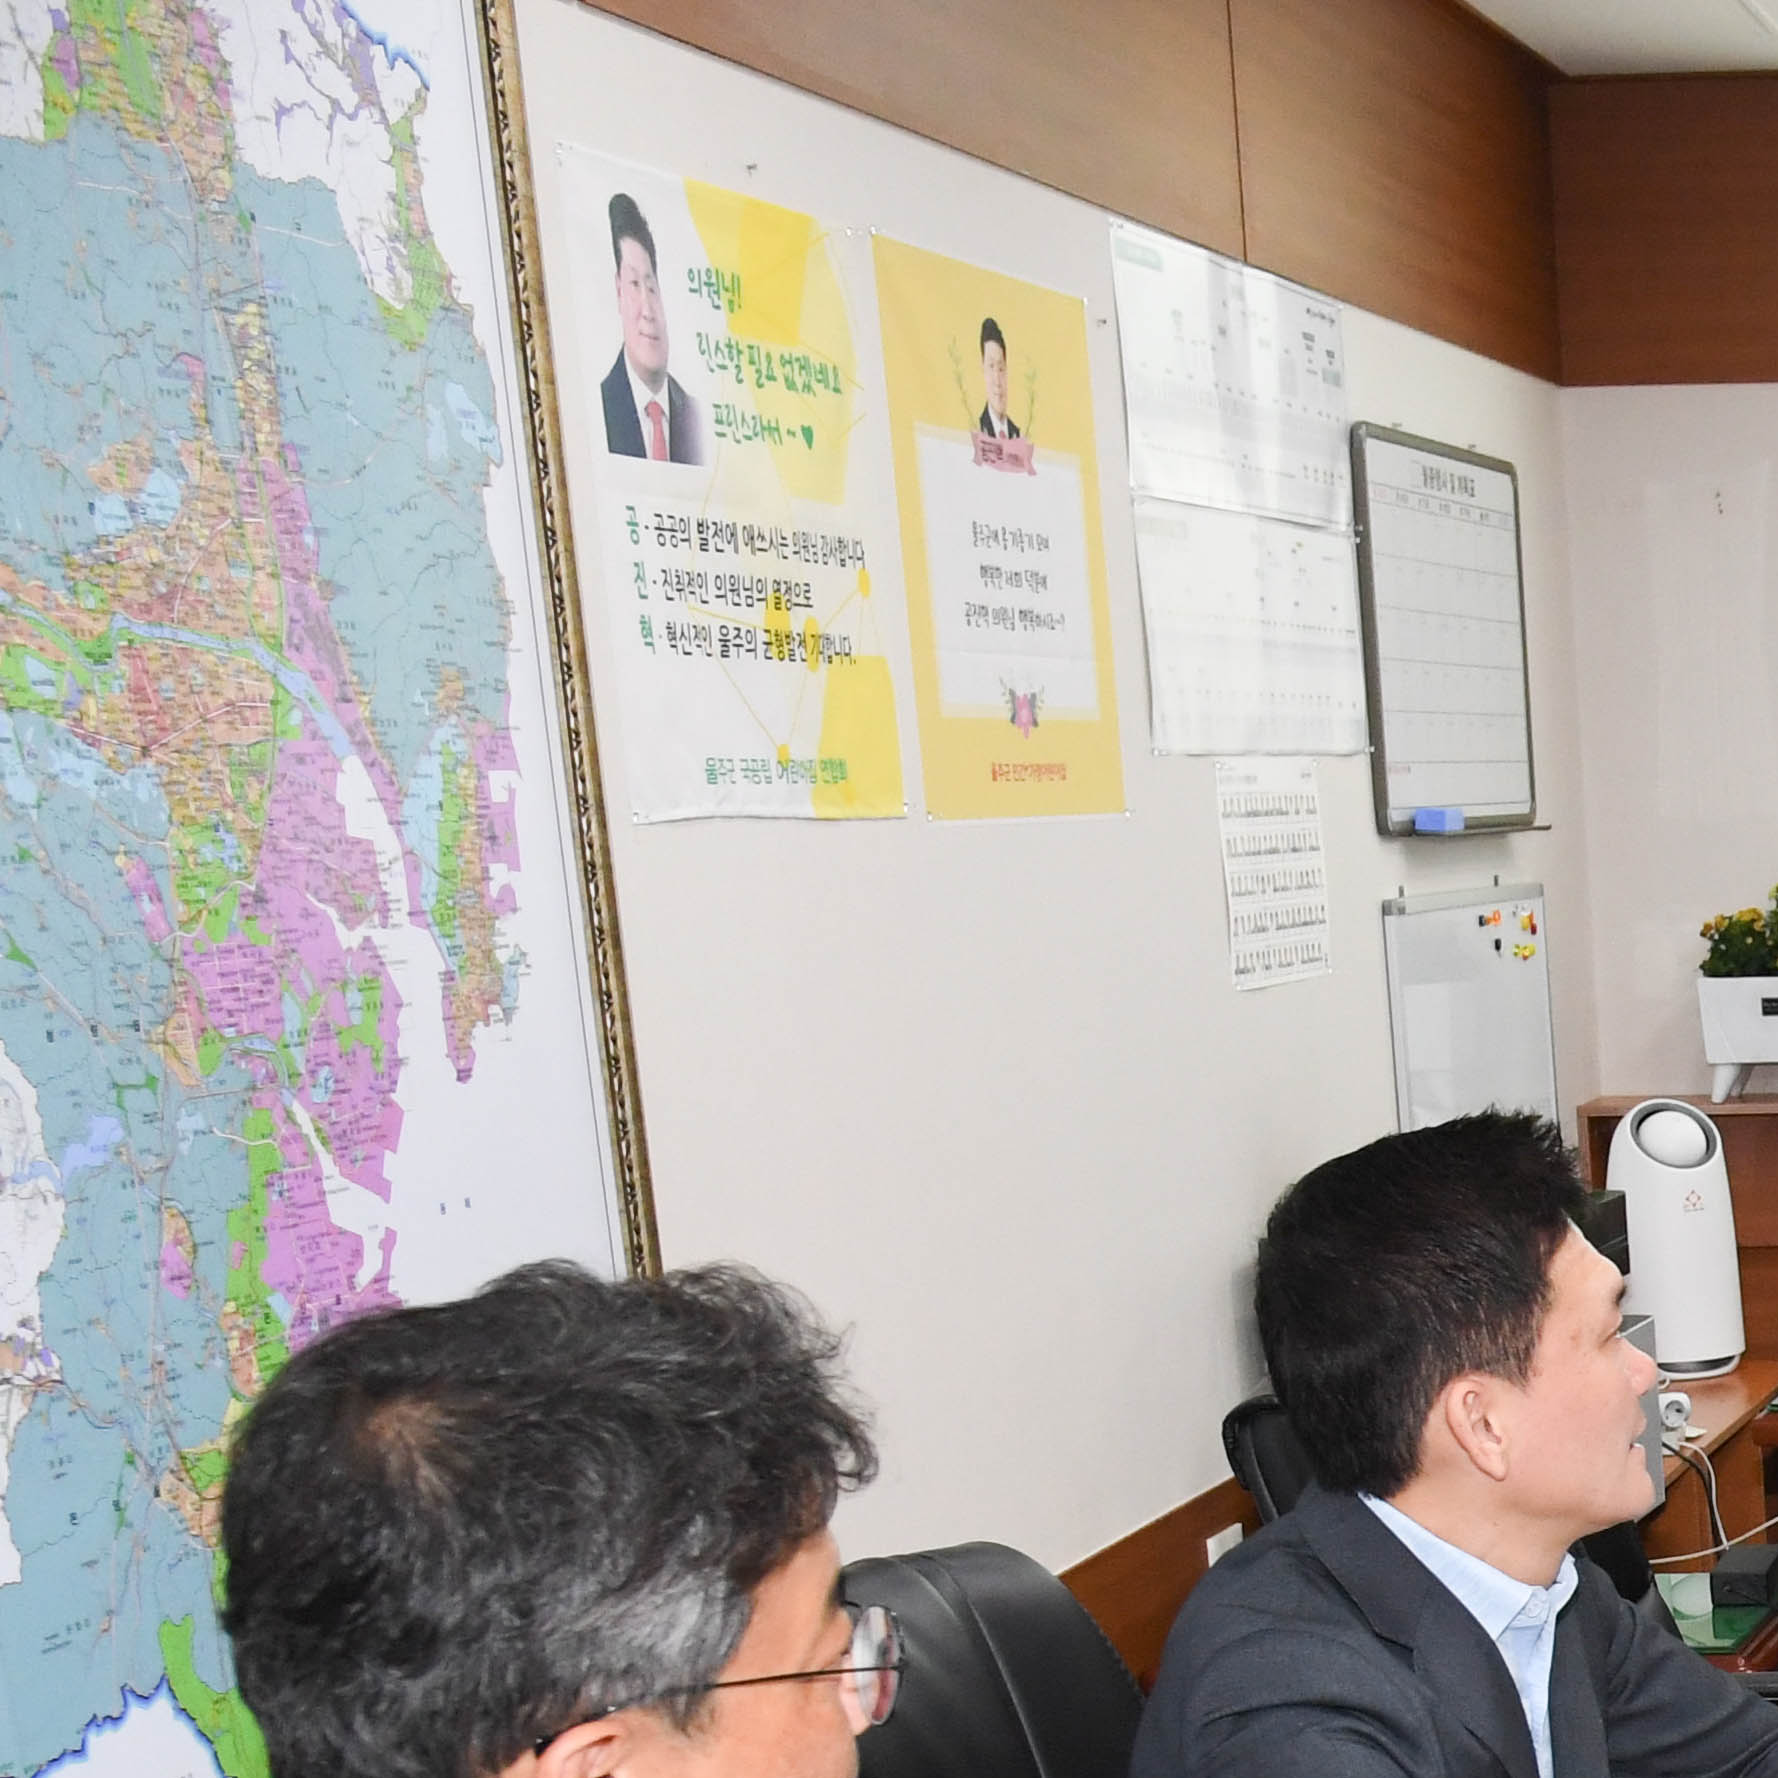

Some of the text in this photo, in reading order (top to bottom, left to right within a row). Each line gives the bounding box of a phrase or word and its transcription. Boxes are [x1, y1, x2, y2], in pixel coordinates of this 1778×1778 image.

[747, 344, 778, 388] 필요
[626, 505, 640, 545] 공
[654, 513, 692, 549] 공공의
[697, 517, 739, 554] 발전에
[634, 560, 649, 600] 진
[661, 569, 710, 604] 진취적인
[715, 573, 769, 607] 의원님의
[639, 615, 656, 655] 혁
[666, 622, 713, 658] 혁신적인
[718, 625, 757, 660] 울주의
